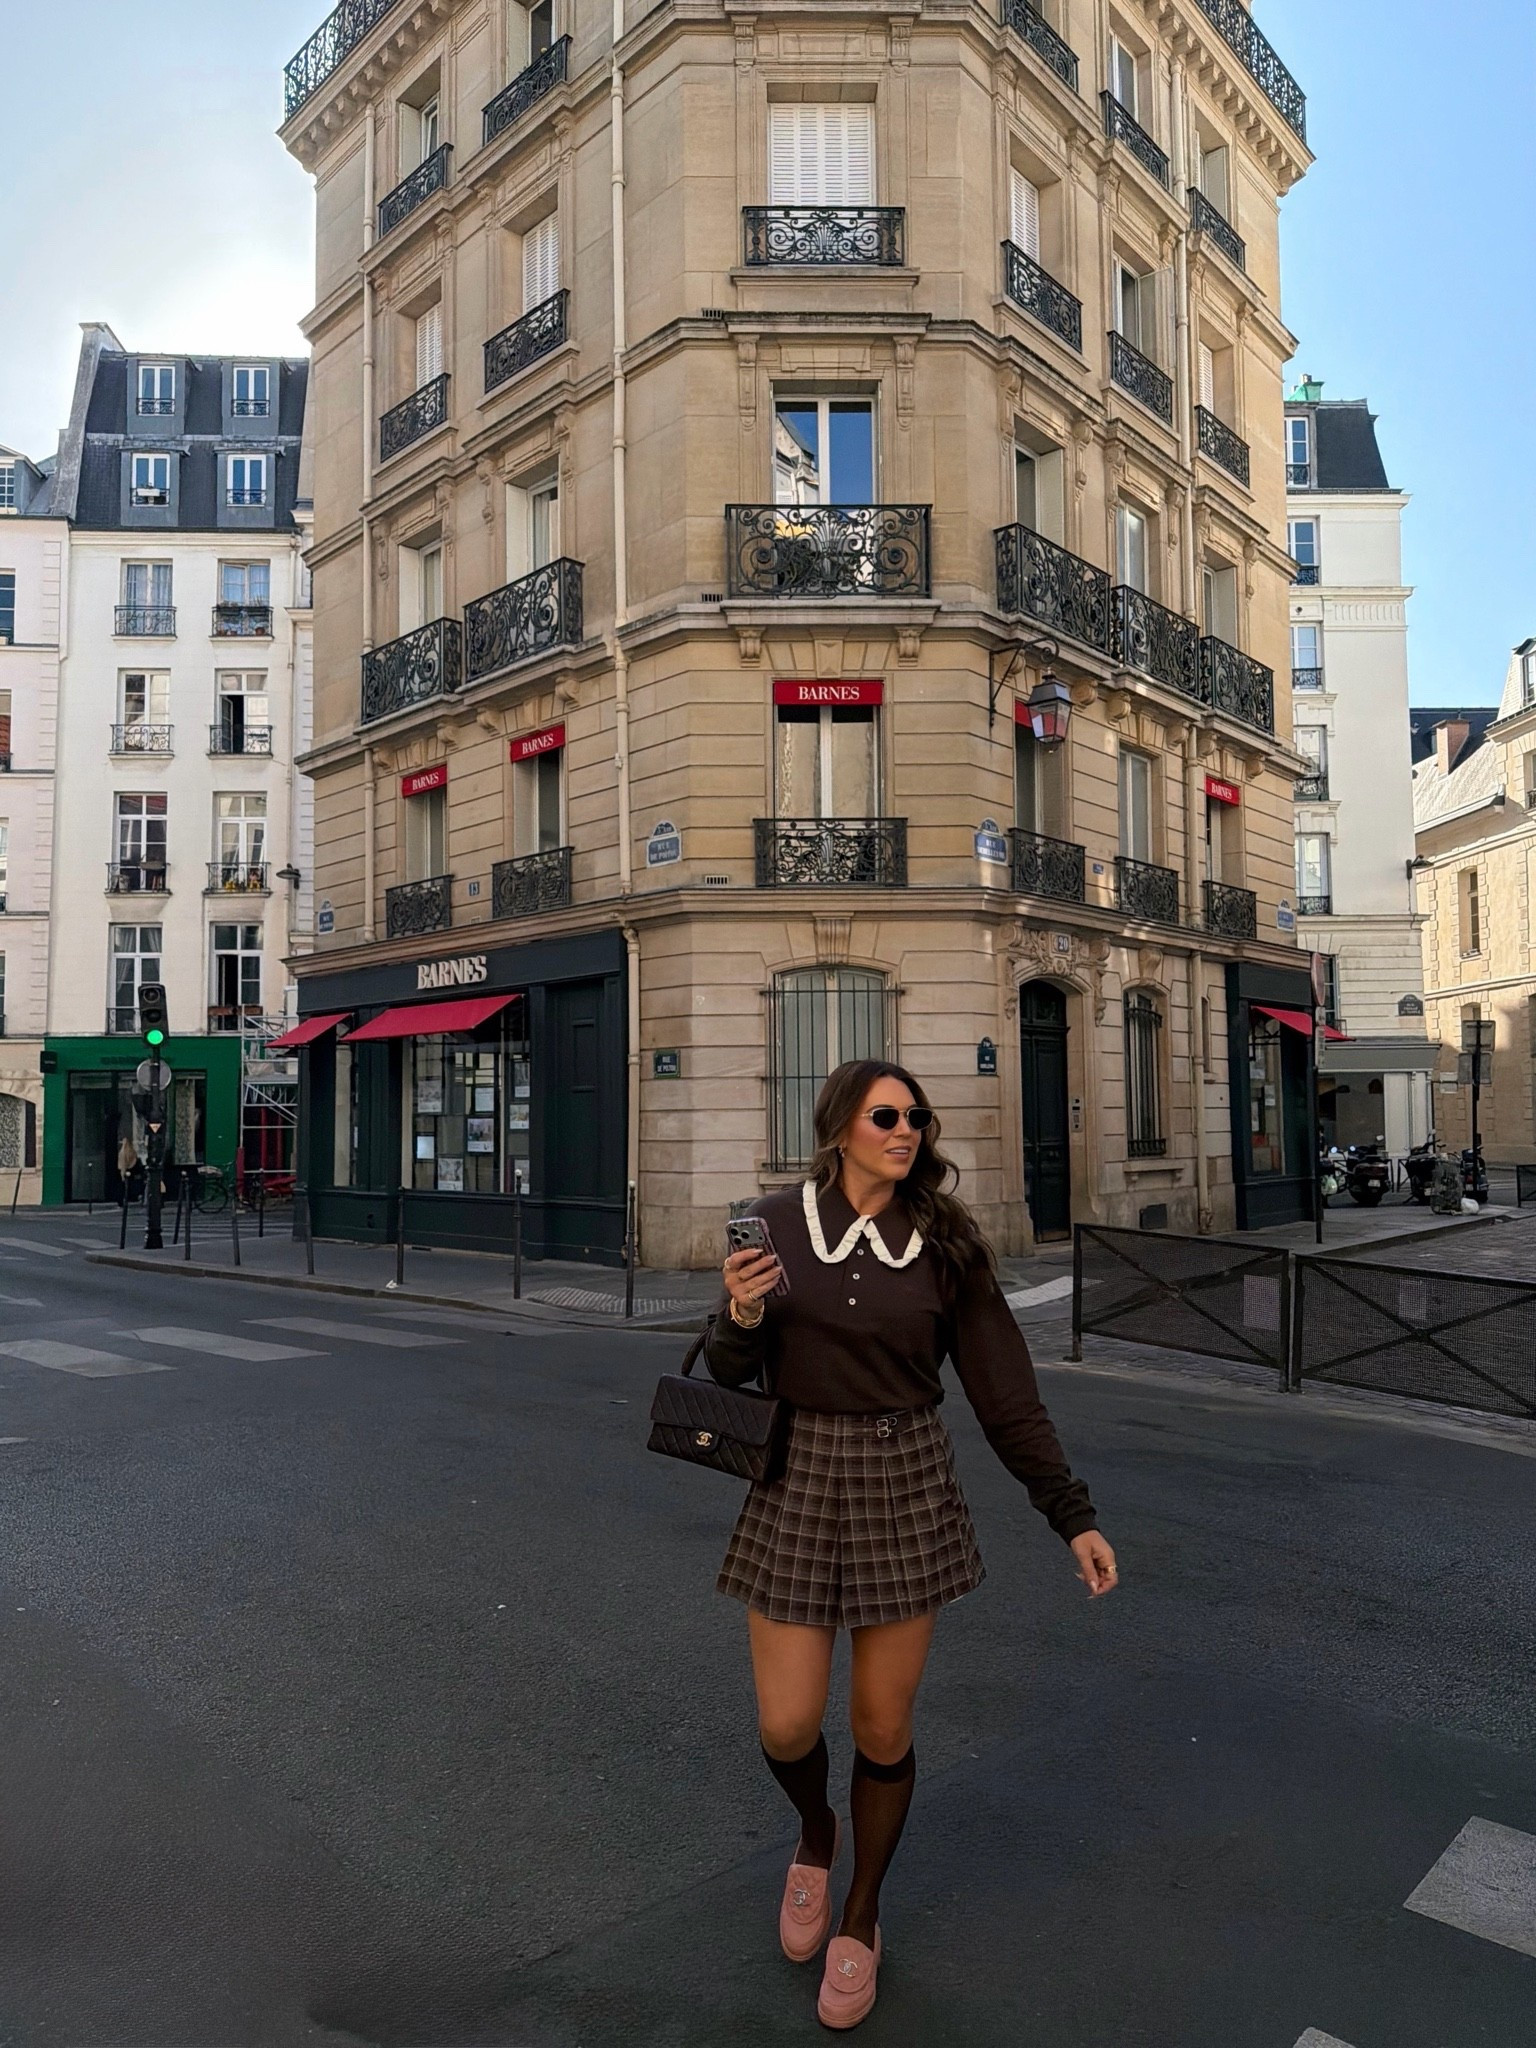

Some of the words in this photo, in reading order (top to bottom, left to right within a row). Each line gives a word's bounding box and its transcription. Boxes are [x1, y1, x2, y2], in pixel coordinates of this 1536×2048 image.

[798, 686, 860, 700] BARNES
[521, 733, 554, 755] BARNES
[412, 771, 439, 791] BARNES
[1211, 782, 1232, 800] BARNES
[1058, 936, 1068, 950] 20
[416, 955, 488, 990] BARNES
